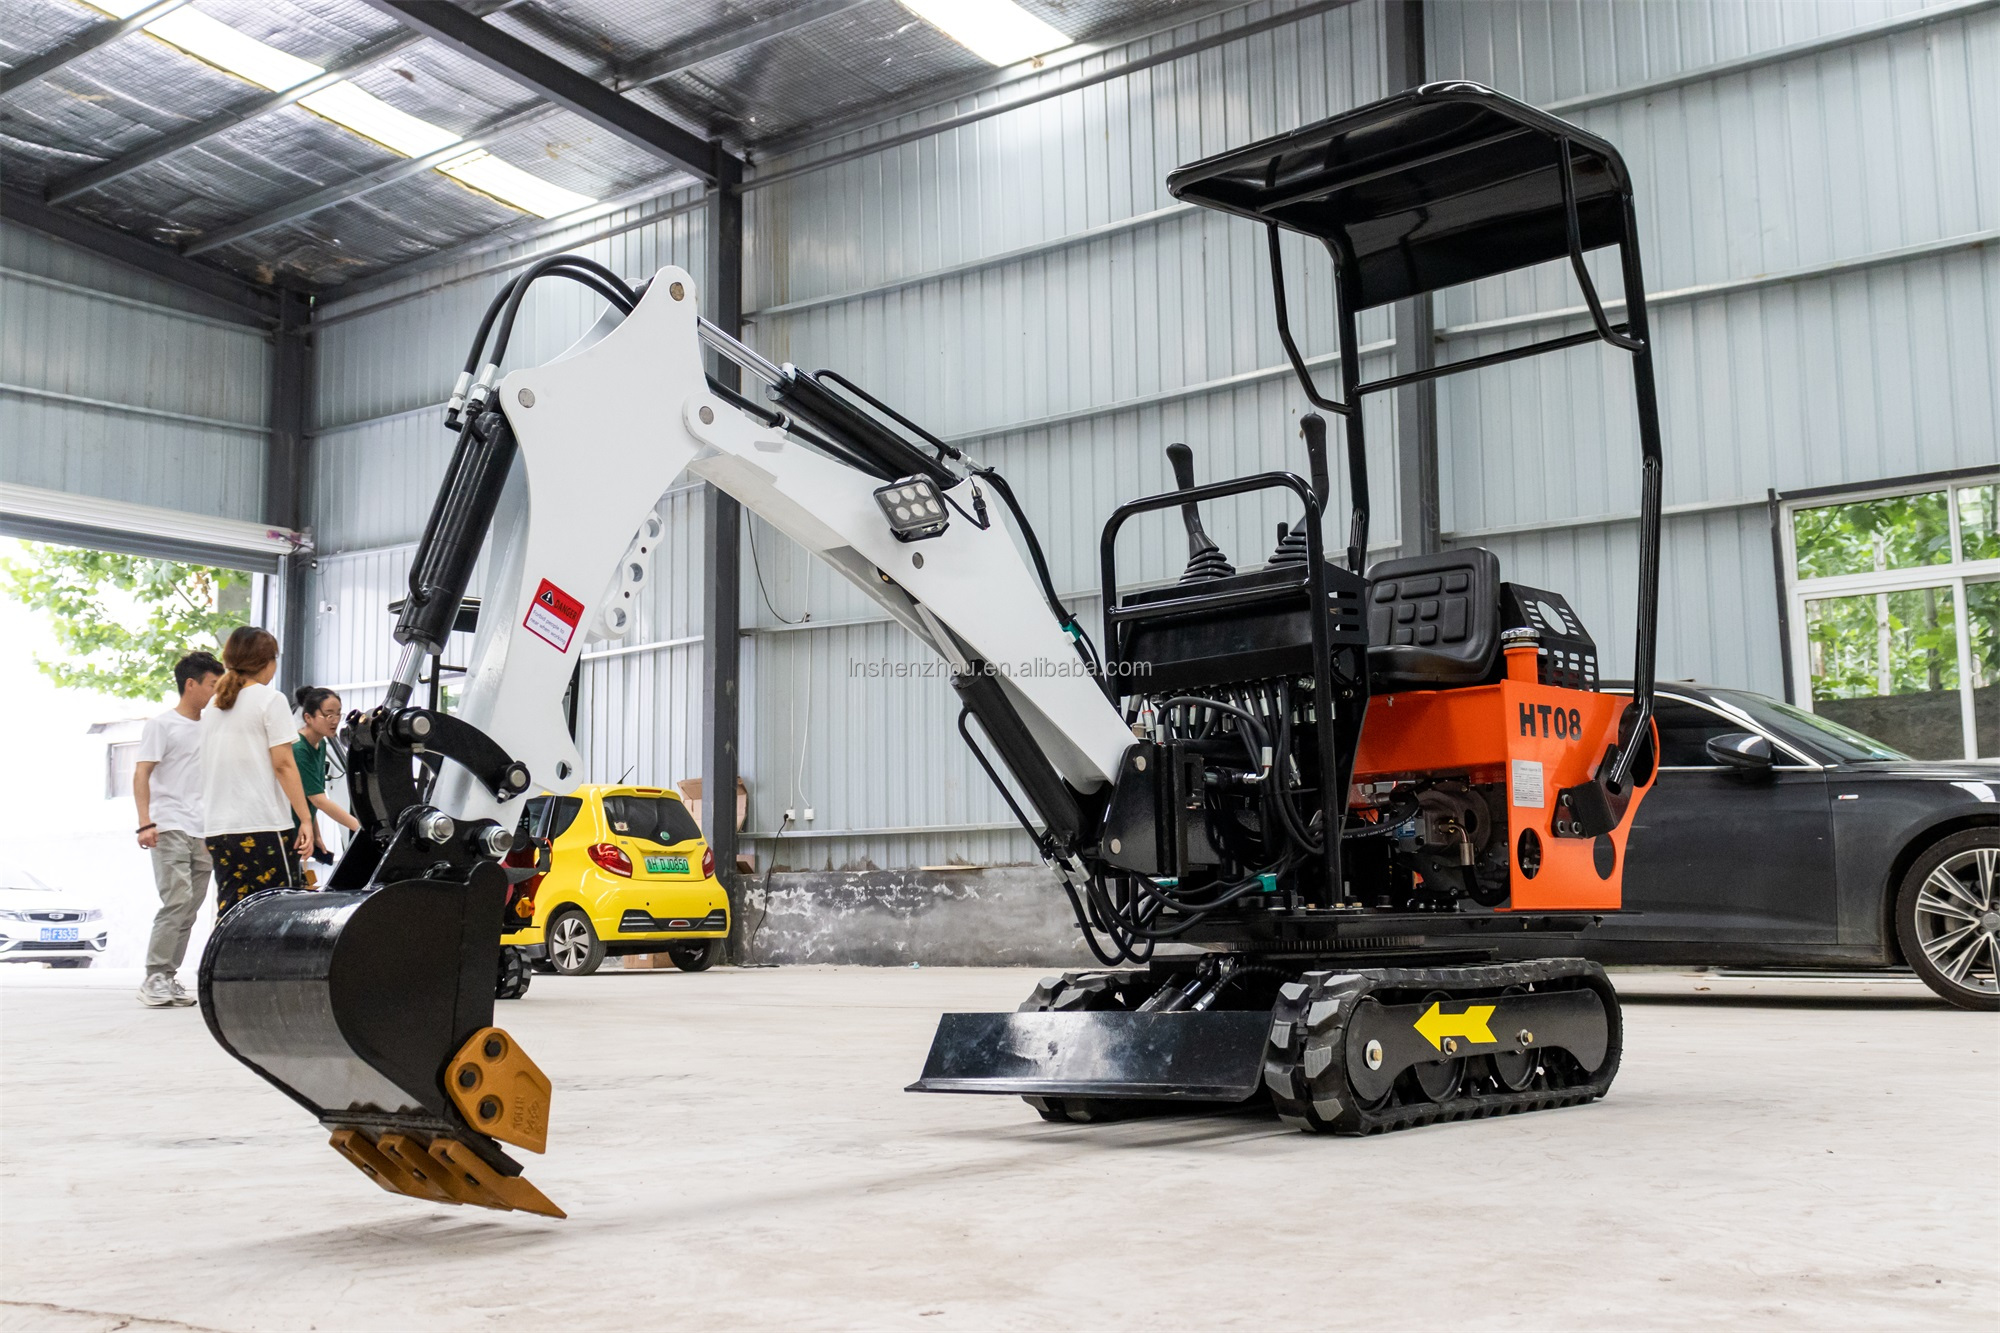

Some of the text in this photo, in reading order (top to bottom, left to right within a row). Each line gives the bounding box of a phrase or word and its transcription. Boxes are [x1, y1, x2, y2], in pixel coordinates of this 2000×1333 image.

[533, 609, 547, 622] Forbid
[545, 619, 560, 631] people
[554, 599, 578, 620] DANGER
[530, 617, 566, 645] near when working
[1519, 702, 1582, 741] HT08
